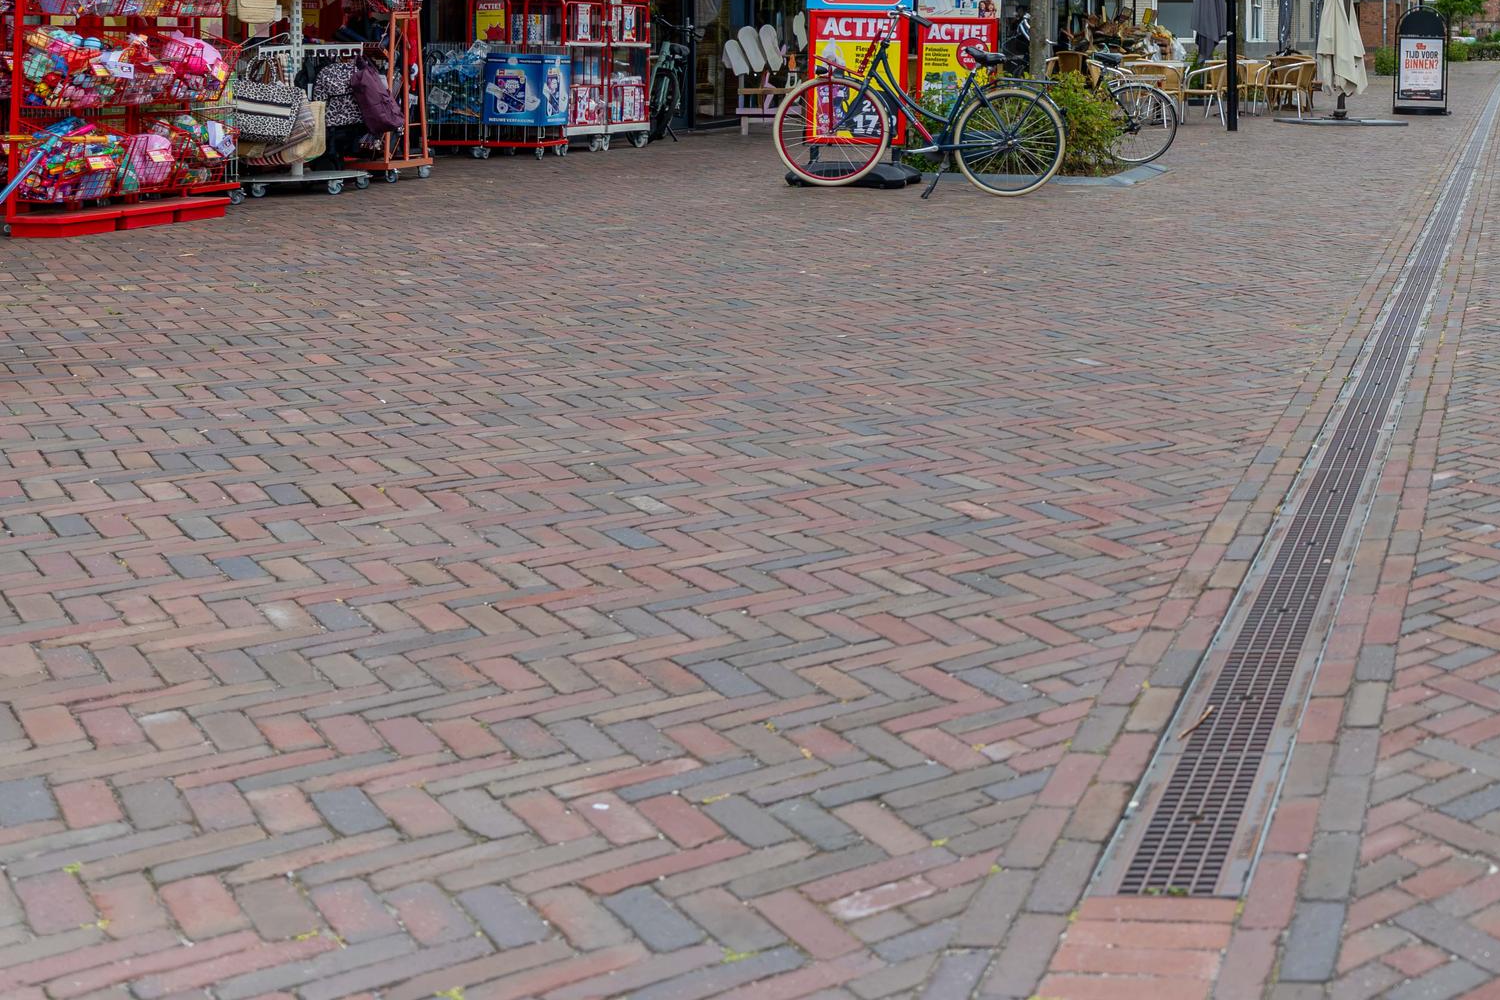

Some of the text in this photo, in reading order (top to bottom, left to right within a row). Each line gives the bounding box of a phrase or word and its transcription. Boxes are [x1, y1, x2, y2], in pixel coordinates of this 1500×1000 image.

[822, 17, 898, 39] ACTIE!
[927, 23, 988, 42] ACTIE!
[1405, 50, 1439, 59] TIJD VOOR
[1404, 60, 1439, 70] BINNEN?
